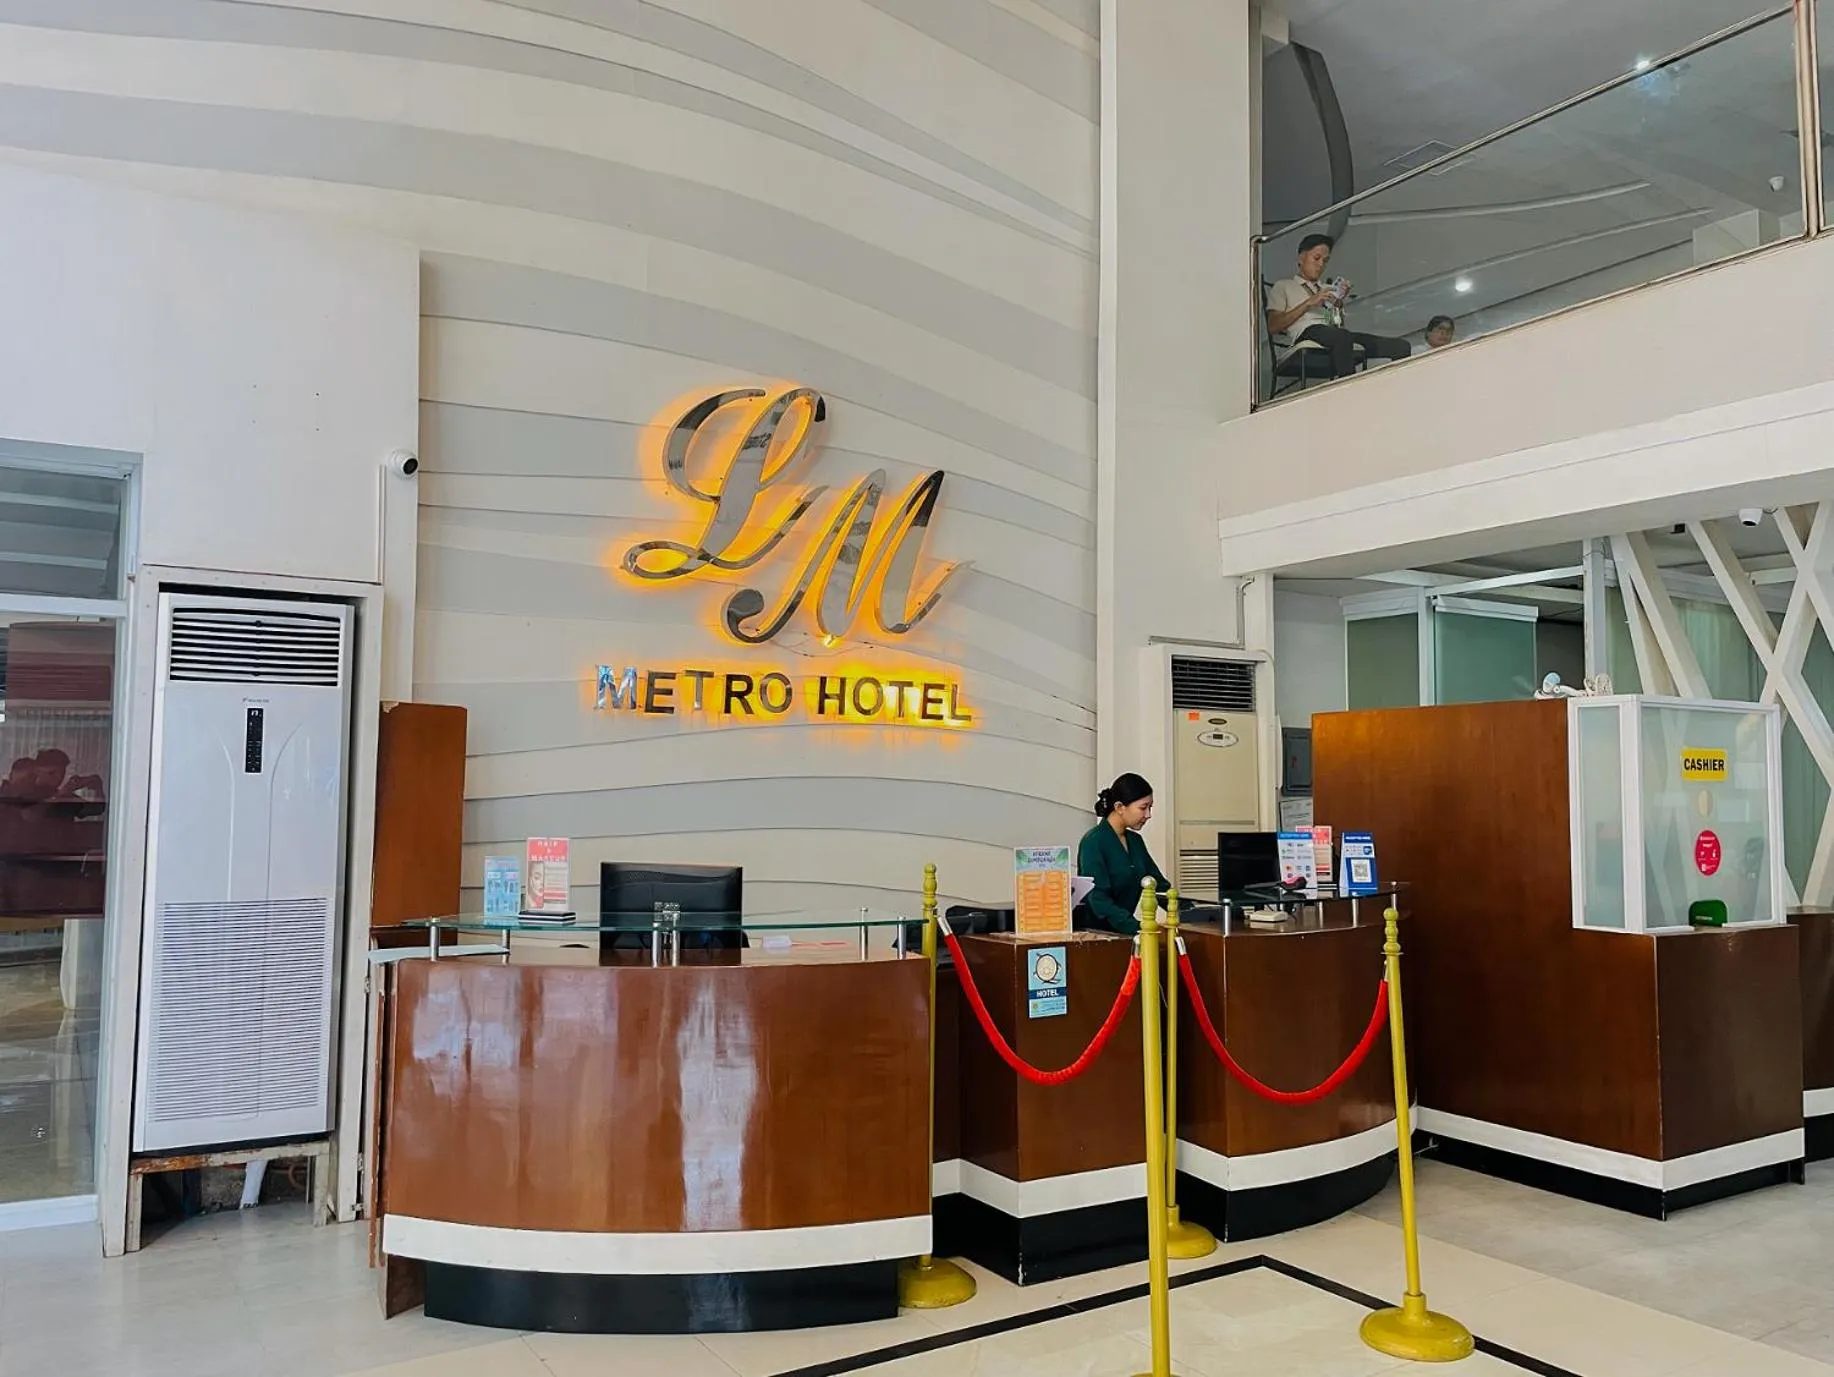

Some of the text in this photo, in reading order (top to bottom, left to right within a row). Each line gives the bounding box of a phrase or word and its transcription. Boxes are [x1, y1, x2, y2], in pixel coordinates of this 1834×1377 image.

[594, 664, 972, 721] METRO HOTEL
[1683, 758, 1725, 771] CASHIER
[1036, 989, 1059, 998] HOTEL
